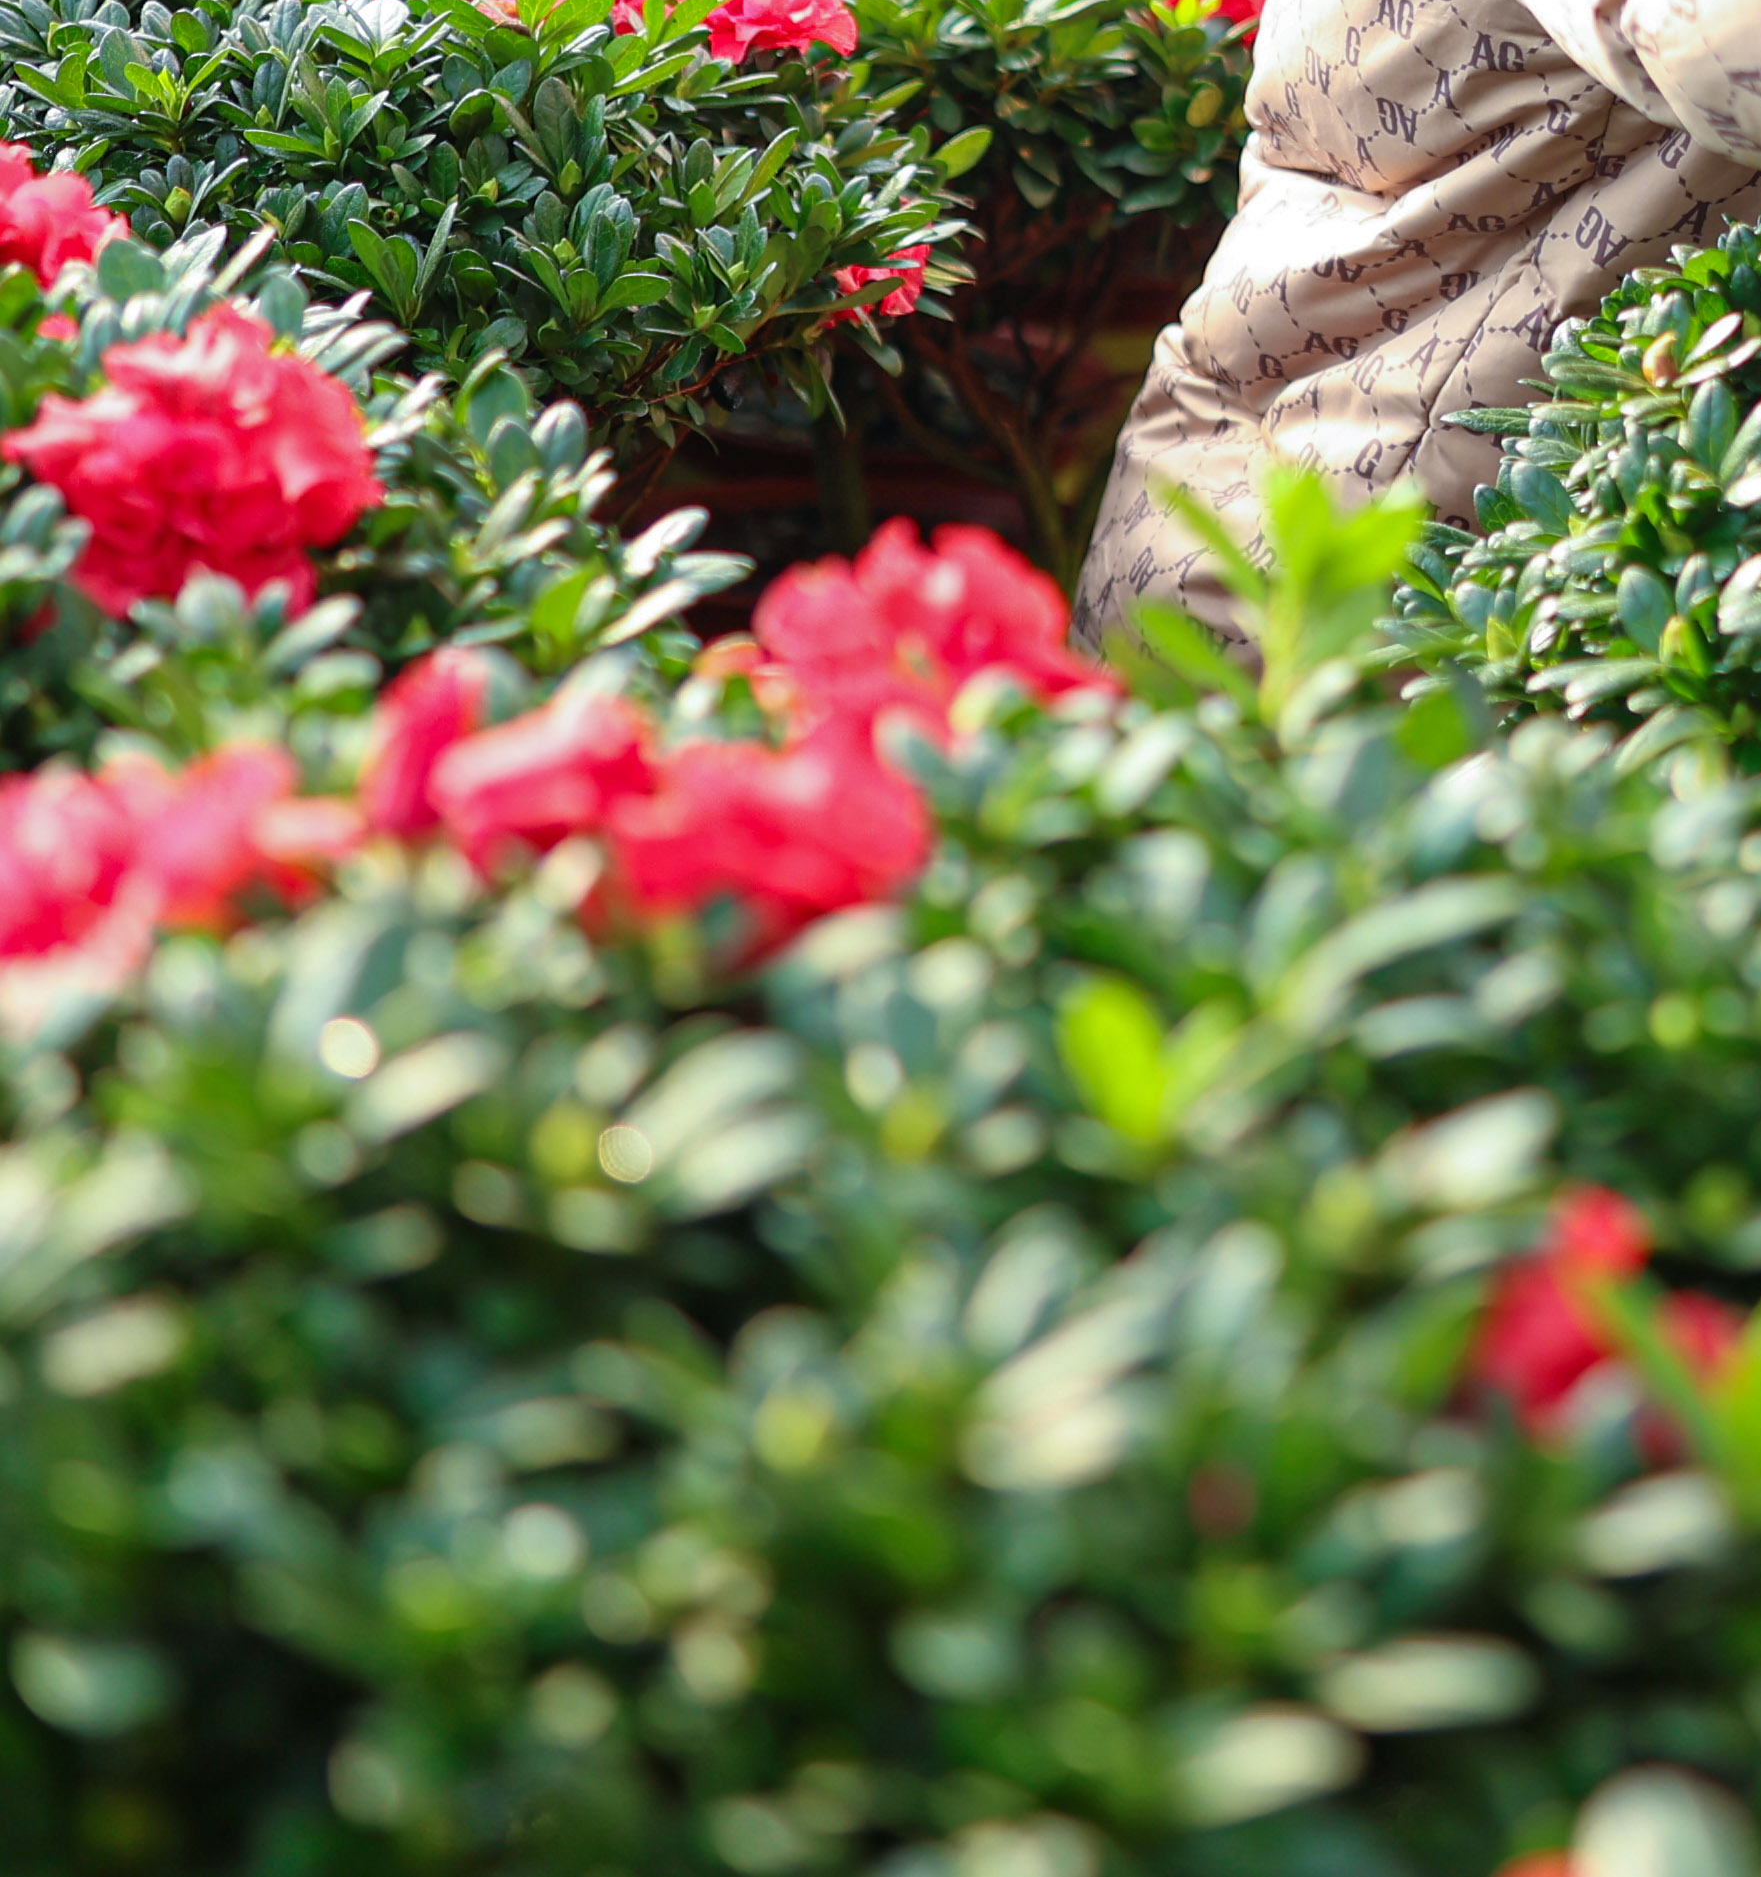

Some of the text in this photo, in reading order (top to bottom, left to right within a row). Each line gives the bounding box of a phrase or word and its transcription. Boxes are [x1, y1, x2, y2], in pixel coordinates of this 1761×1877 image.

[1345, 26, 1361, 67] G
[1468, 31, 1525, 72] AG
[1304, 45, 1331, 95] AG
[1434, 67, 1458, 111] A
[1376, 97, 1419, 146] AG
[1546, 98, 1572, 134] G
[1356, 135, 1388, 180] A
[1531, 182, 1556, 207] A
[1448, 213, 1506, 233] AG
[1575, 205, 1629, 269] AG
[1672, 201, 1712, 235] A
[1393, 239, 1429, 258] A
[1230, 266, 1254, 316] AG
[1269, 267, 1289, 306] A
[1381, 308, 1409, 334] G
[1302, 331, 1359, 360] AG
[1409, 334, 1440, 380] A
[1259, 354, 1285, 379] G
[1347, 348, 1385, 395] AG
[1301, 374, 1320, 413] A
[1353, 438, 1383, 480] G
